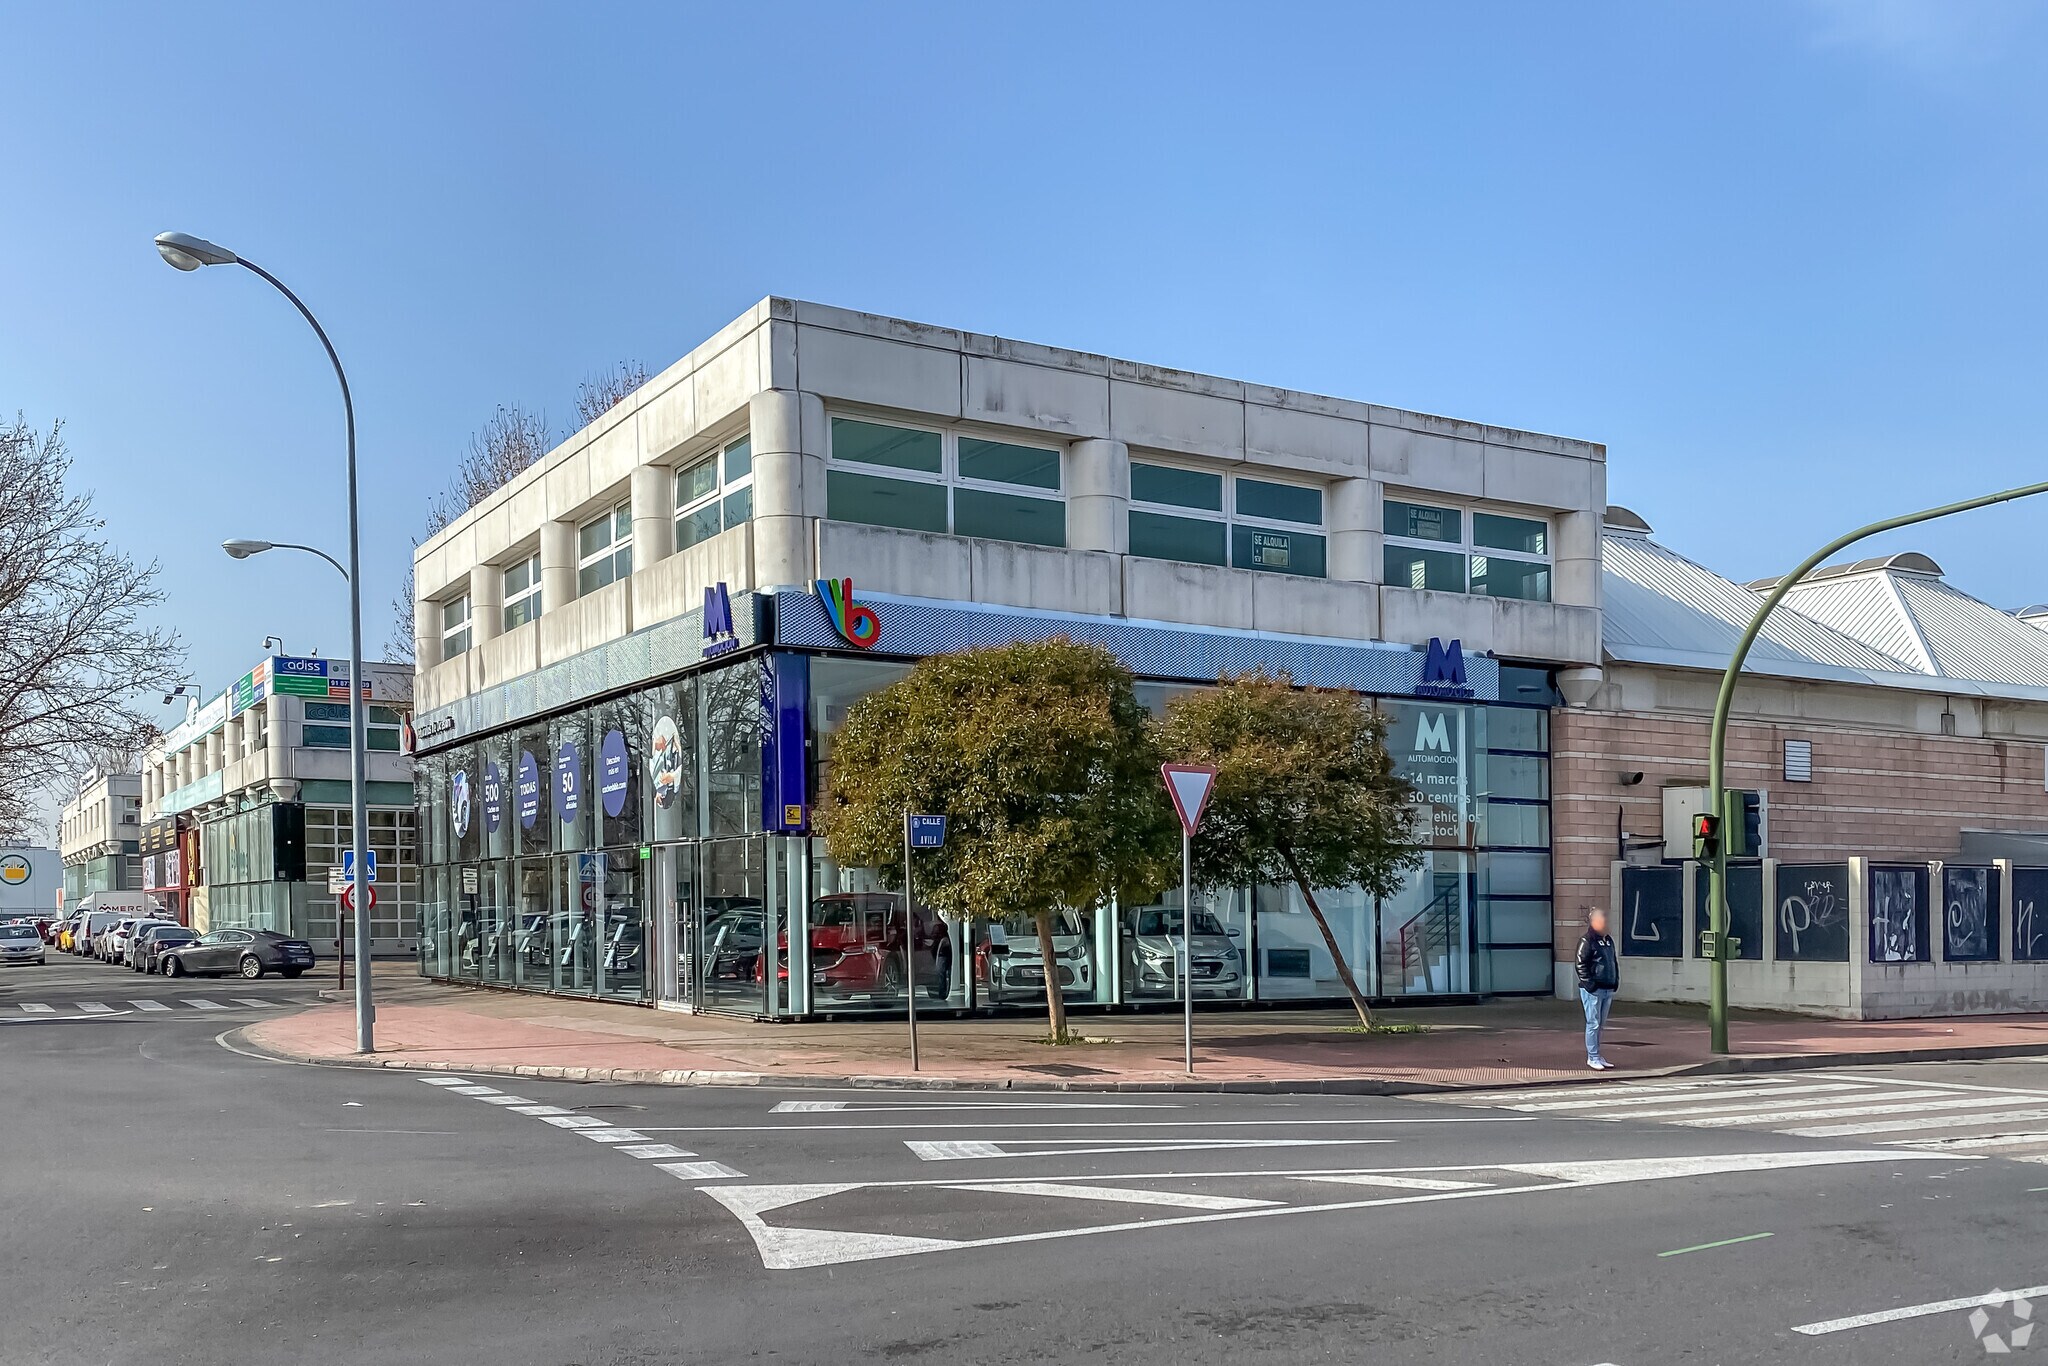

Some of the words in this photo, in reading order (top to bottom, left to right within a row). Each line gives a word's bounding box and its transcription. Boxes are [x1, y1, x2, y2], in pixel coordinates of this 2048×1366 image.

[1254, 535, 1262, 545] SE
[1263, 536, 1288, 548] ALQUILA
[286, 660, 320, 671] adiss
[1424, 637, 1467, 684] M
[1414, 711, 1451, 752] M
[562, 771, 574, 794] 50
[1410, 772, 1423, 784] 14
[485, 782, 500, 803] 500
[1408, 791, 1424, 803] 50
[922, 817, 941, 826] CALLE
